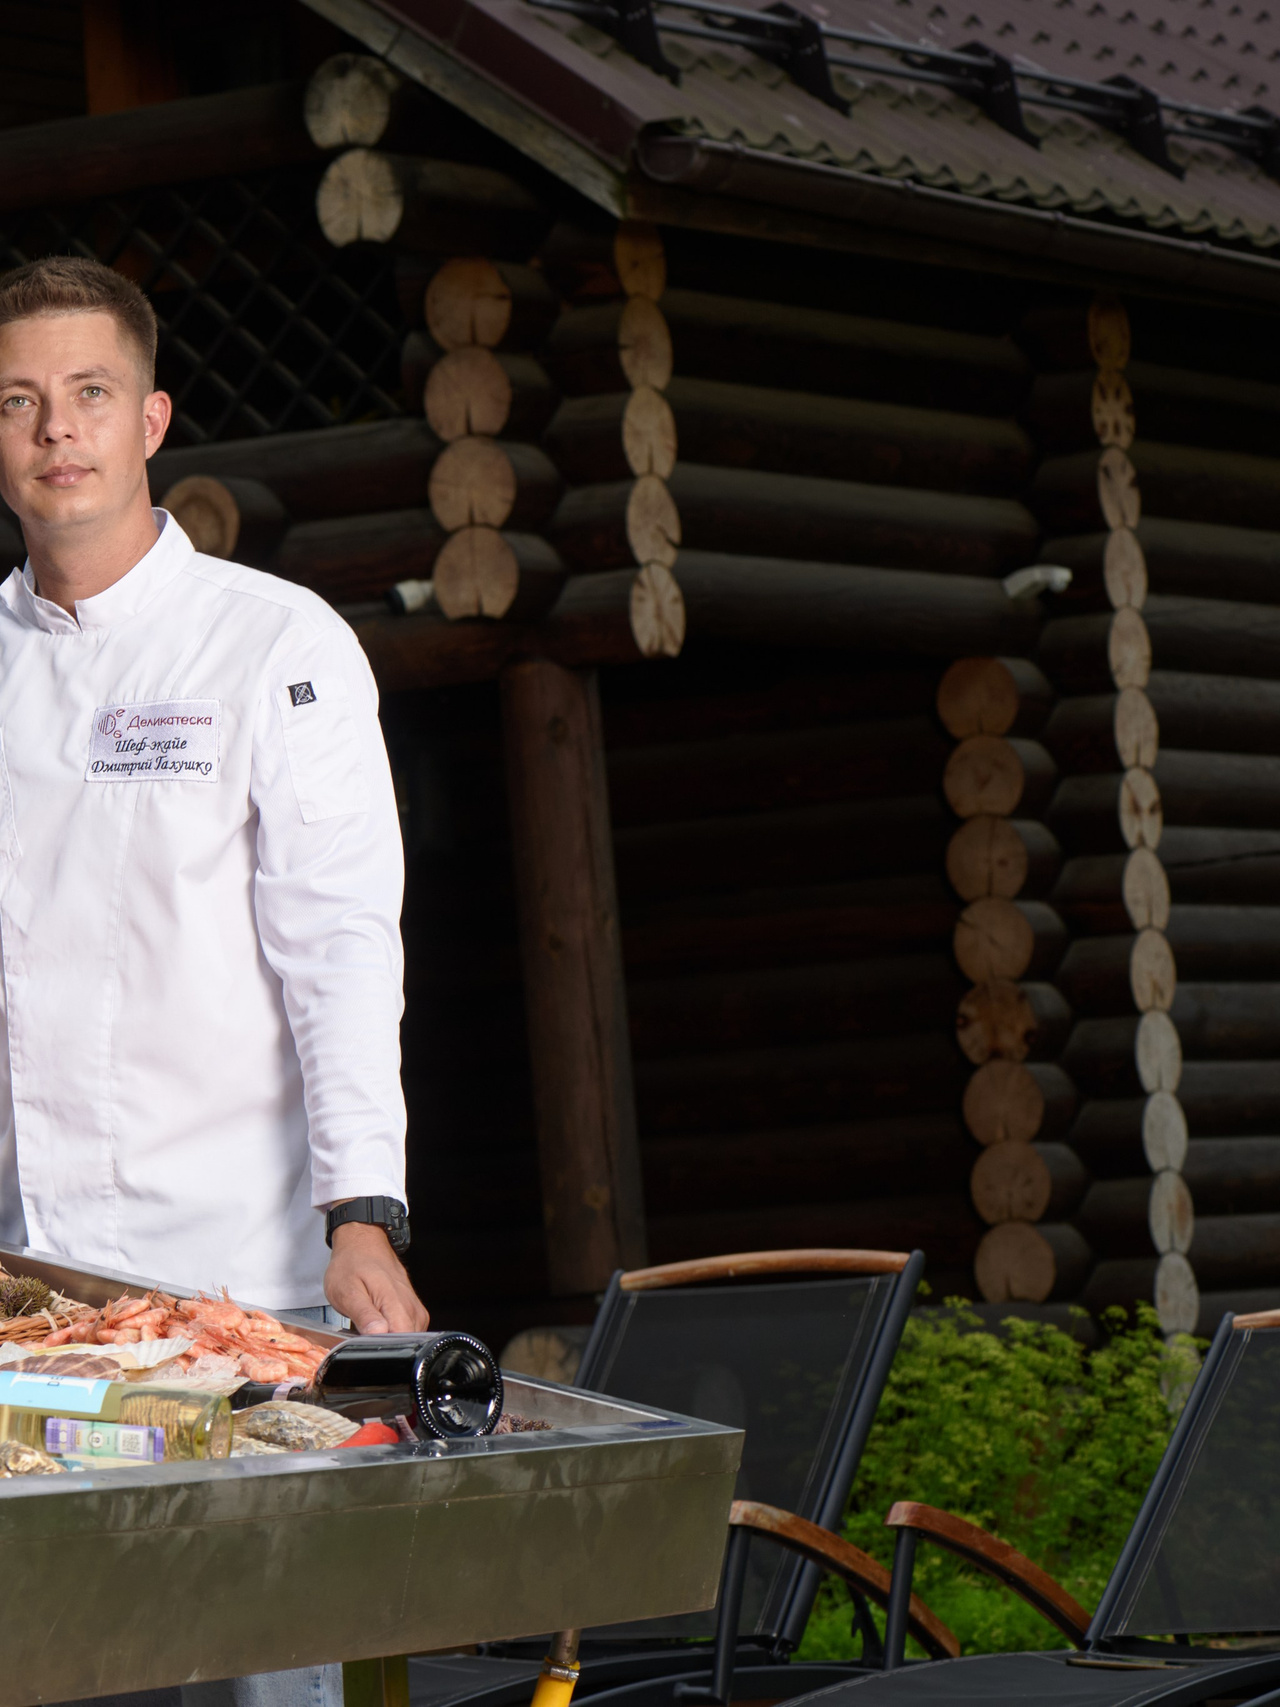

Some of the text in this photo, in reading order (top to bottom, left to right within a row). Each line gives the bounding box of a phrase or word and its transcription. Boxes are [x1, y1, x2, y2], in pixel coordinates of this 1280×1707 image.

[126, 715, 213, 730] Деликатеска
[115, 737, 187, 755] Шеф-экайе
[91, 755, 213, 776] Дмитрий Галушко
